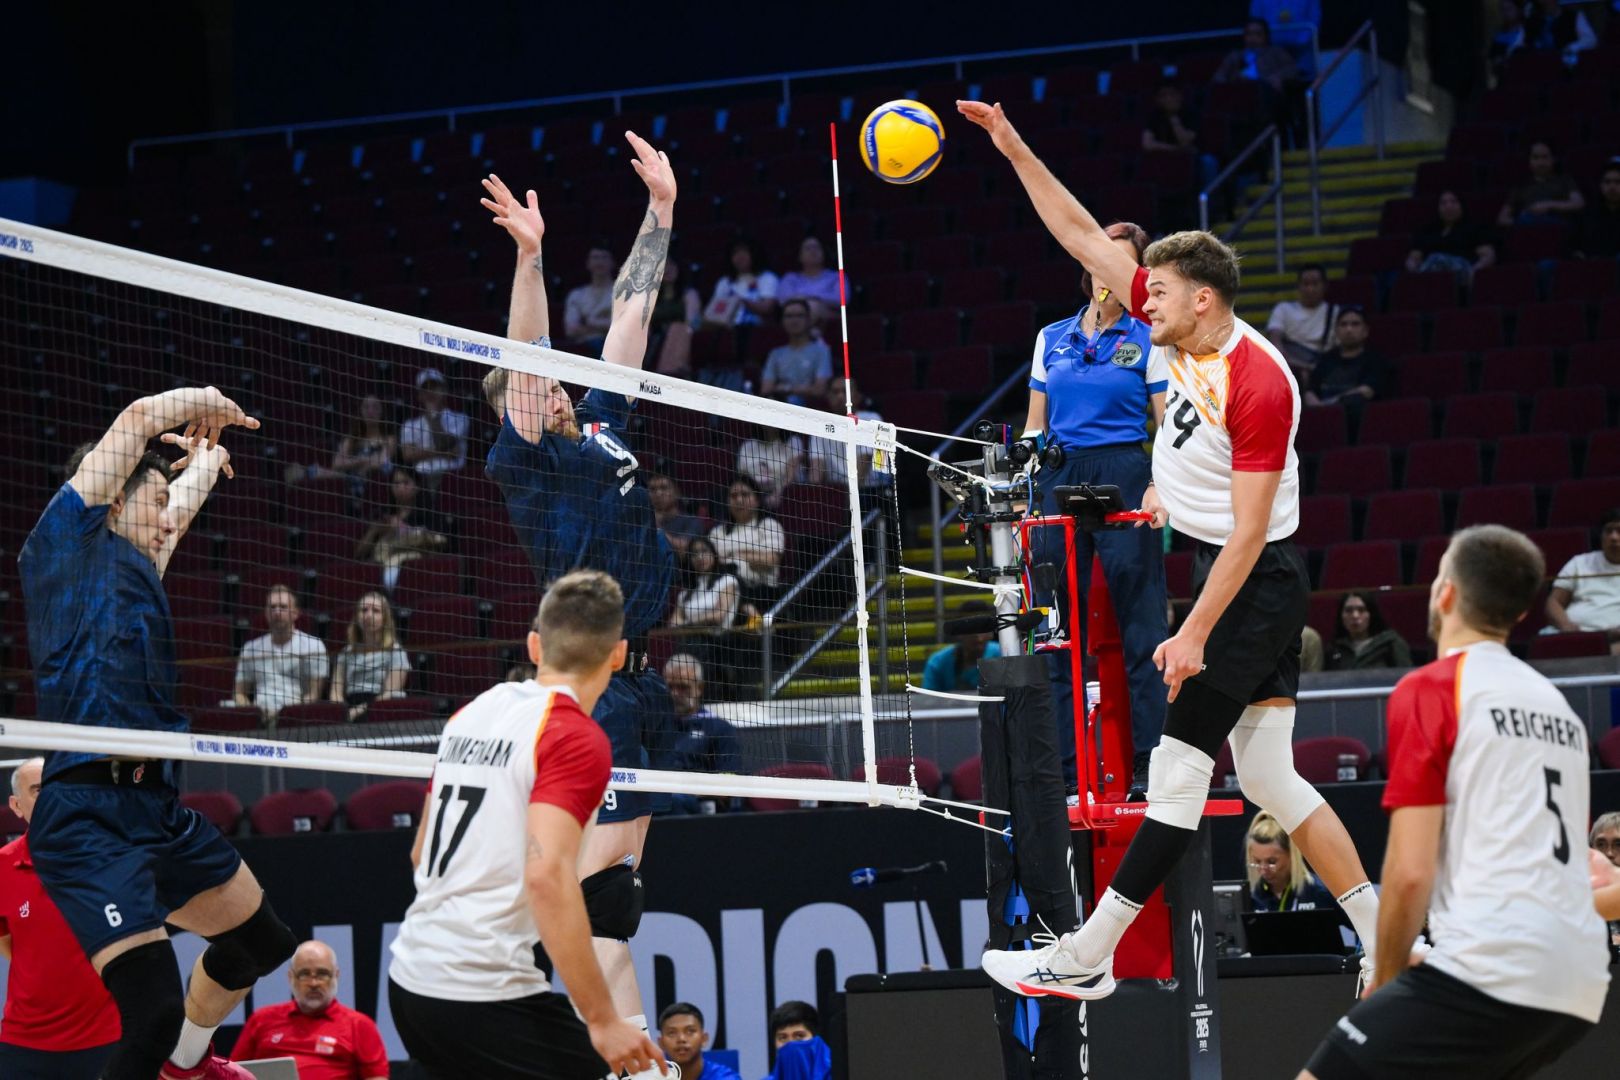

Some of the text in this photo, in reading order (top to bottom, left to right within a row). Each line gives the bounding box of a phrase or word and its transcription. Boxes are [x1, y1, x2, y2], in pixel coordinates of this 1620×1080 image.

[423, 332, 445, 348] VOLLEYBALL
[447, 337, 460, 351] WORLD
[490, 347, 501, 360] 2025
[639, 379, 662, 395] MIKASA
[1489, 708, 1584, 752] REICHERT
[196, 740, 222, 754] VOLLEYBALL
[224, 742, 241, 755] WORLD
[276, 746, 288, 759] 2025
[604, 789, 618, 811] 9
[1122, 806, 1148, 815] Seno
[1543, 766, 1571, 866] 5
[427, 784, 488, 879] 17
[104, 903, 123, 928] 6
[1195, 1017, 1209, 1039] 2025
